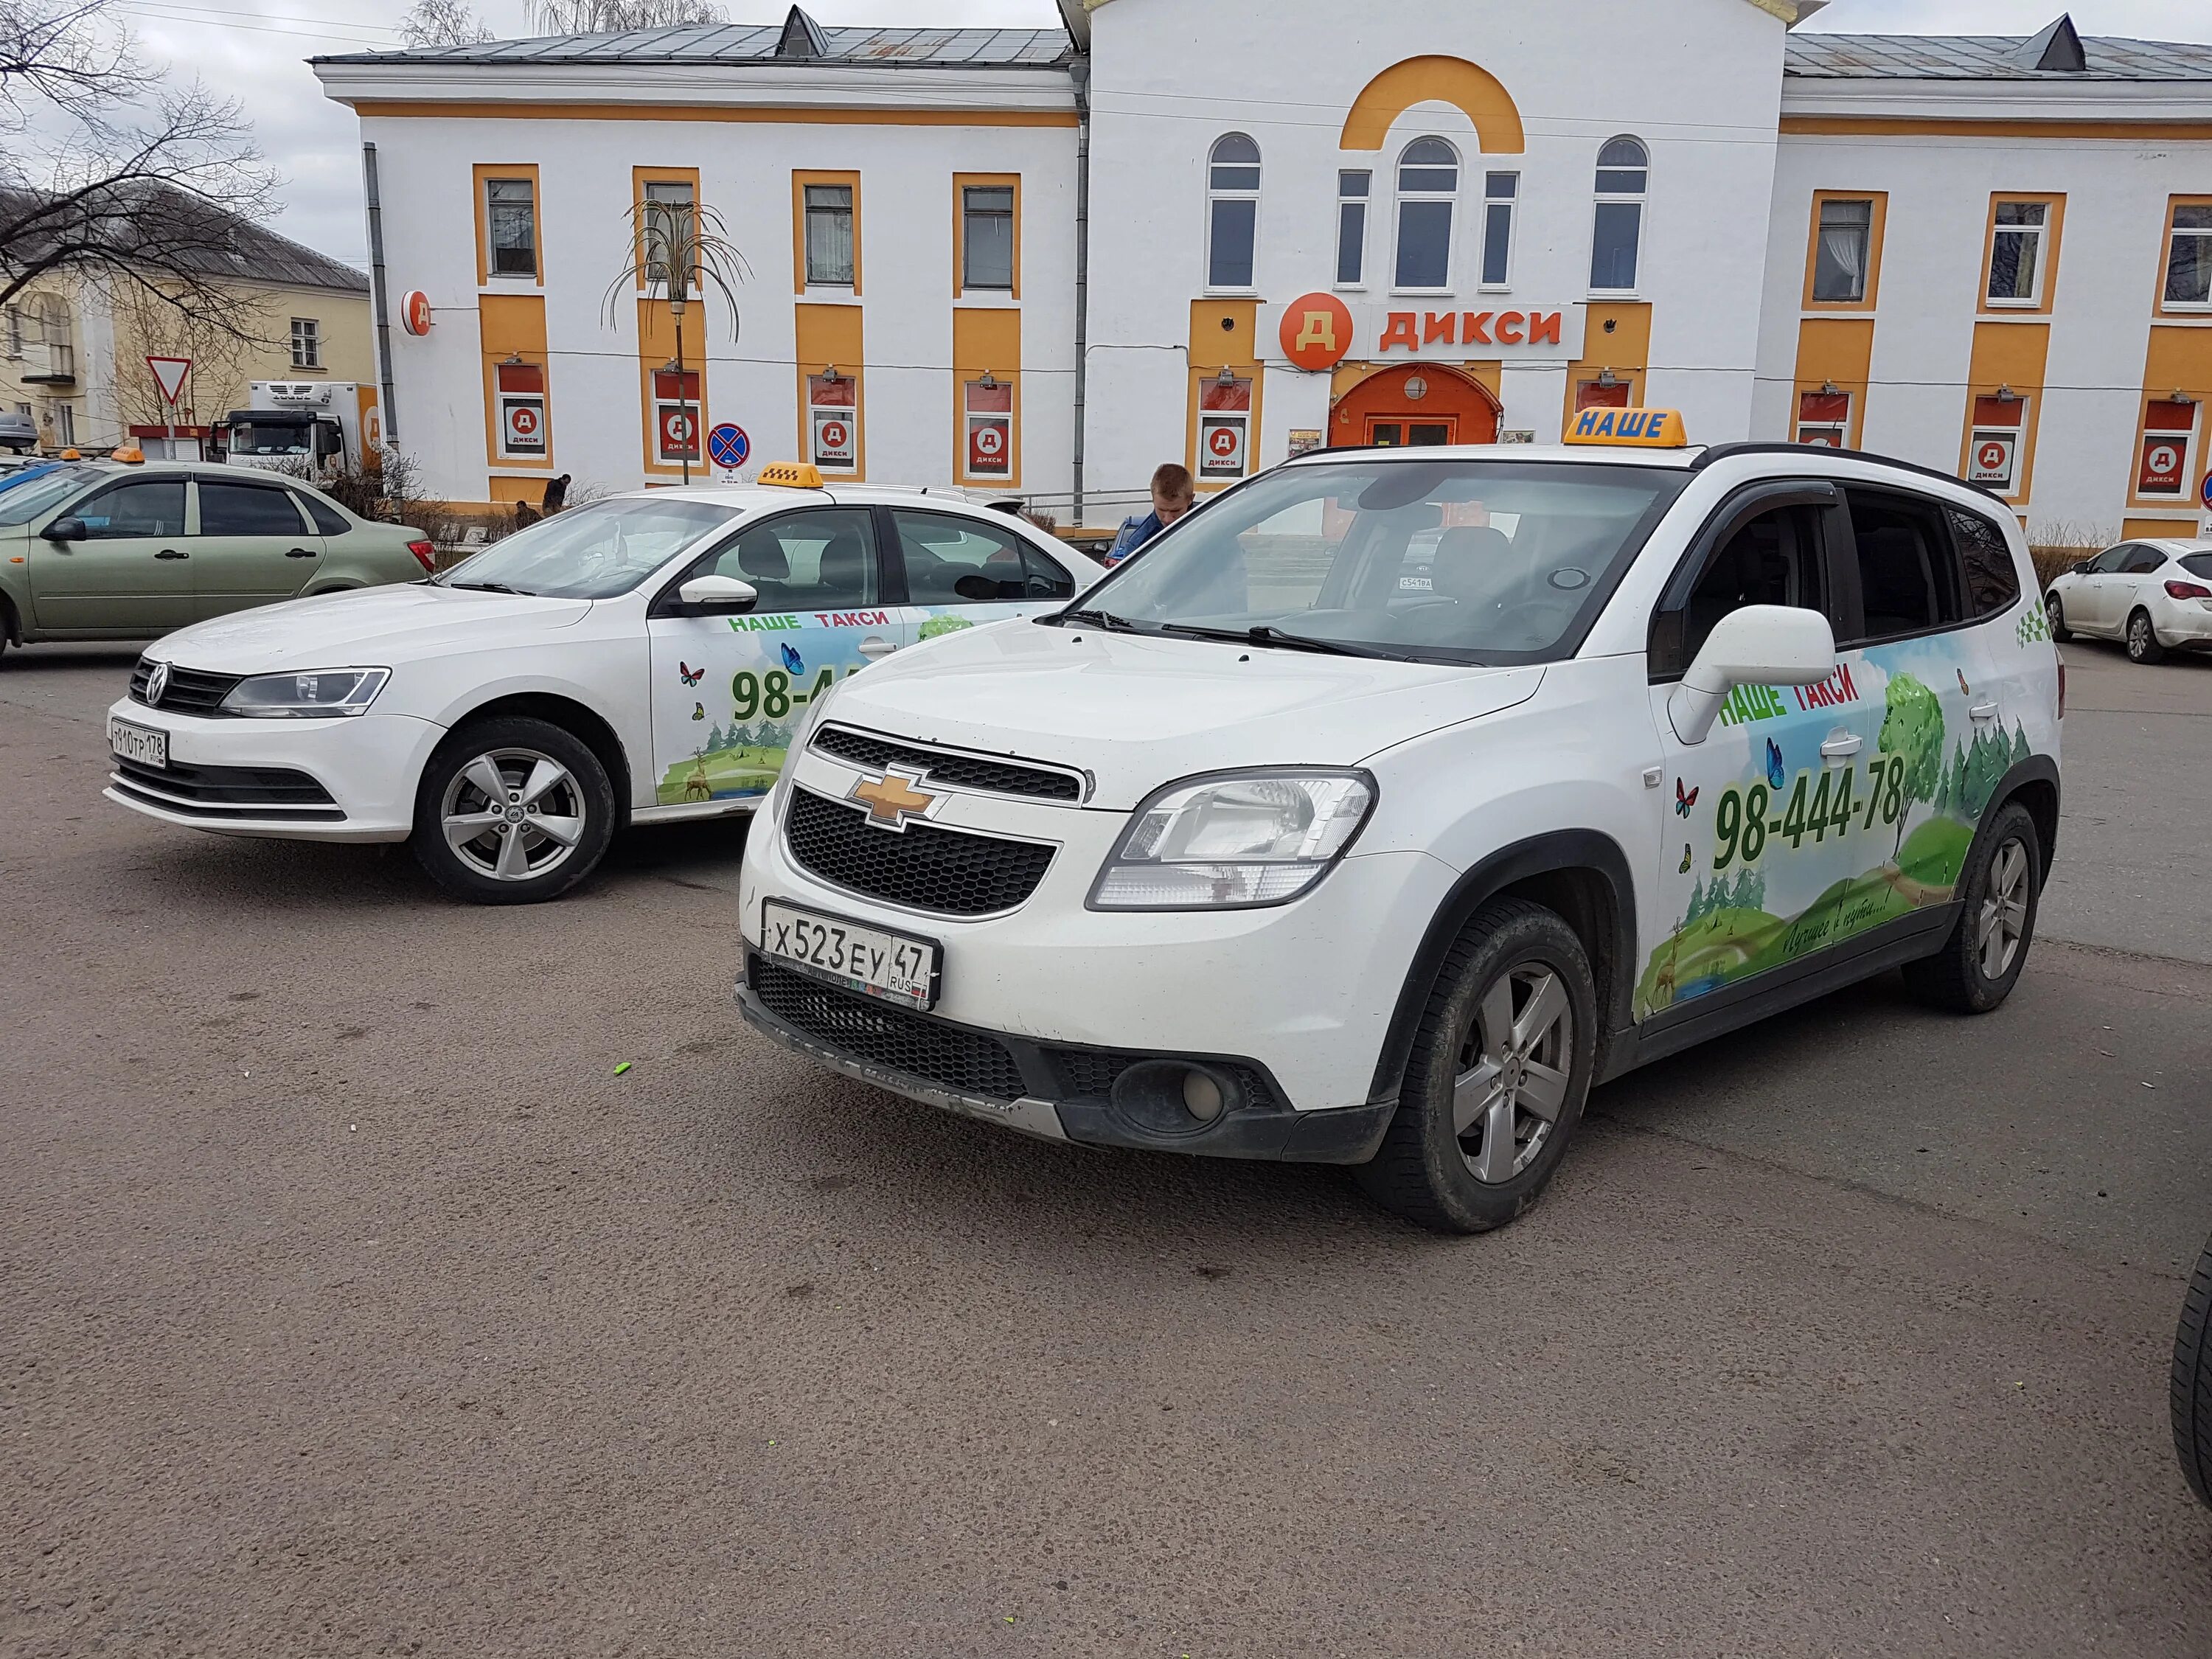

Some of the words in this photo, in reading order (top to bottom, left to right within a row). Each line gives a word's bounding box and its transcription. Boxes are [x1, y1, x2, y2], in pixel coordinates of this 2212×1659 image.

[417, 302, 429, 325] Д
[1295, 310, 1336, 352] Д
[1379, 311, 1562, 352] ДИКСИ
[518, 414, 532, 428] Д
[1575, 411, 1668, 438] НАШЕ
[827, 428, 842, 442] Д
[982, 434, 997, 448] Д
[1215, 435, 1231, 451] Д
[1983, 449, 1999, 464] Д
[2154, 453, 2170, 467] Д
[1975, 471, 2004, 479] ДИКСИ
[727, 615, 802, 633] НАШЕ
[814, 611, 891, 628] ТАКСИ
[147, 734, 164, 756] 178
[150, 754, 159, 762] RUS
[1713, 756, 1905, 870] 98-444-78
[775, 919, 885, 981] Х523ЕУ
[894, 944, 923, 981] 47
[889, 975, 911, 992] RUS
